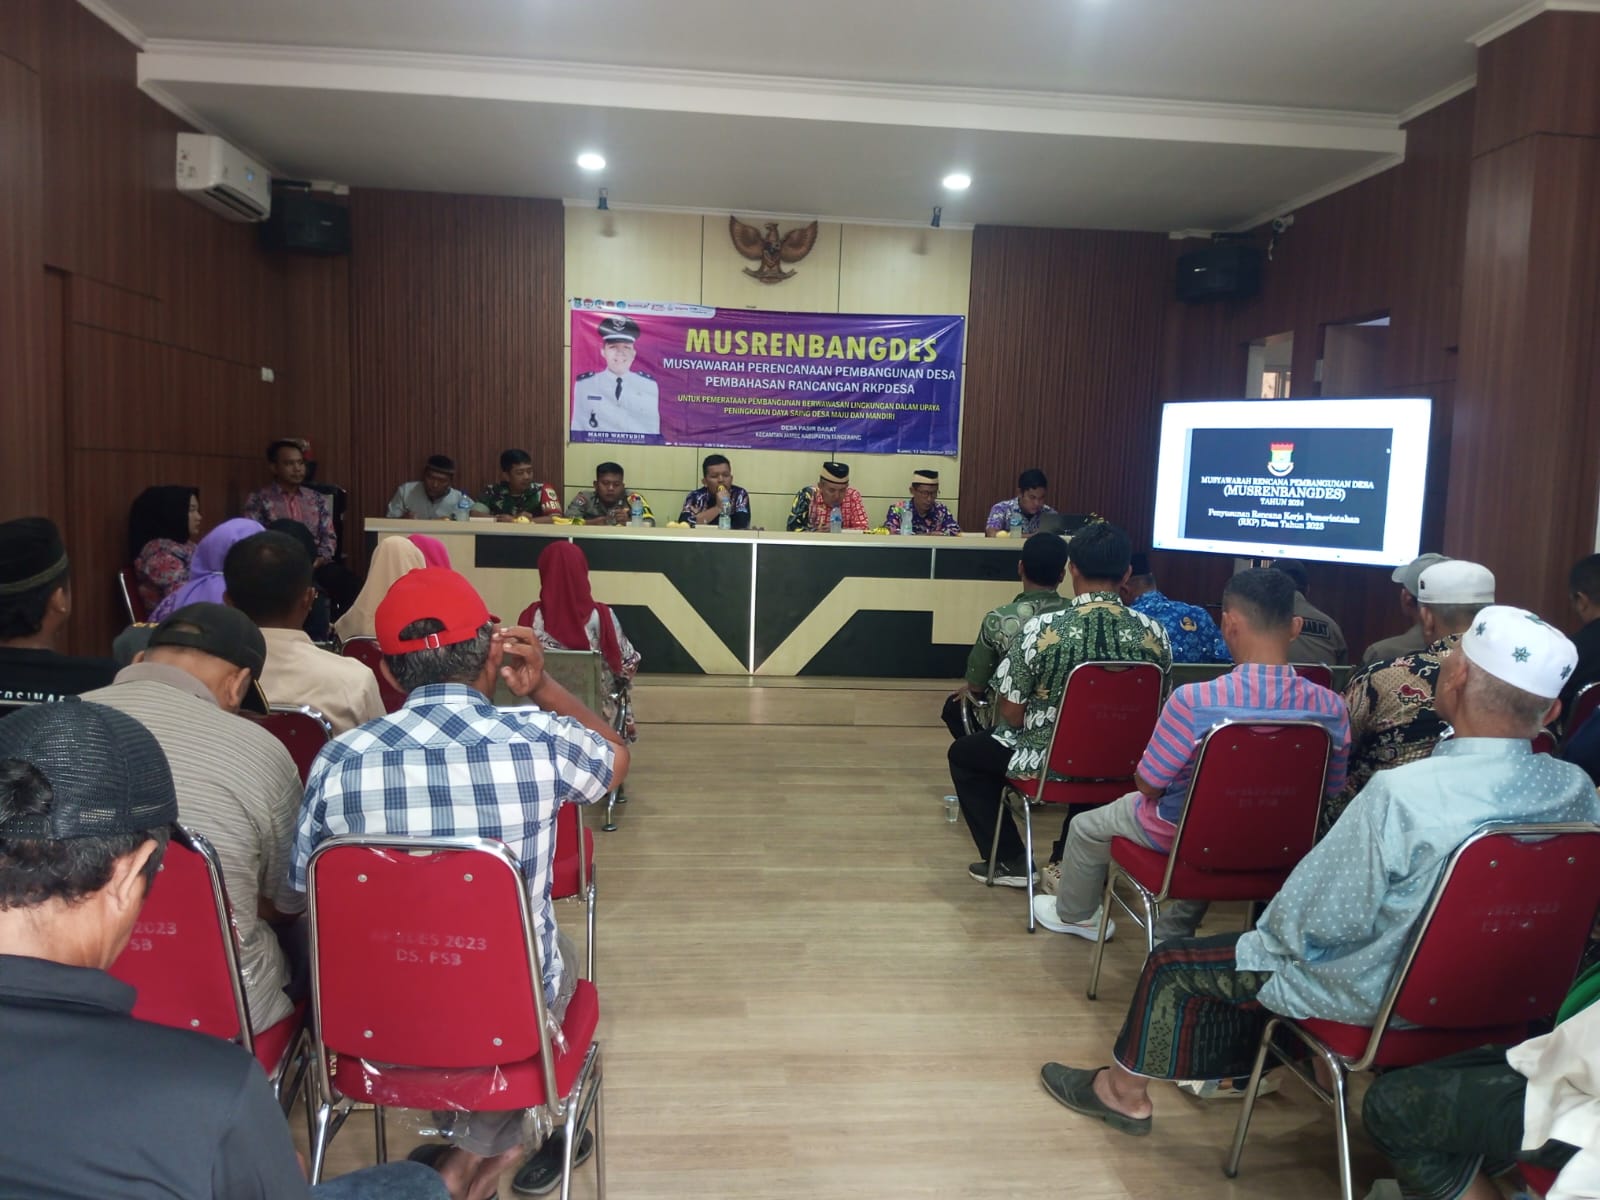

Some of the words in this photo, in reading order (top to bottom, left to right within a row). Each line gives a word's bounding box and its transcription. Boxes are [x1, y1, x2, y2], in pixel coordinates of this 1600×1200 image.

[685, 328, 937, 363] MUSRENBANGDES
[663, 358, 745, 372] MUSYAWARAH
[748, 363, 832, 376] PERENCANAAN
[835, 366, 924, 379] PEMBANGUNAN
[926, 369, 956, 380] DESA
[705, 376, 785, 389] PEMBAHASAN
[788, 380, 860, 392] RANCANGAN
[862, 383, 915, 394] RKPDESA
[678, 395, 701, 403] UNTUK
[702, 396, 746, 405] PEMERATAAN
[748, 398, 801, 407] PEMBANGUNAN
[802, 400, 849, 408] BERWAWASAN
[850, 402, 894, 410] LINGKUNGAN
[895, 403, 918, 411] DALAM
[724, 407, 770, 415] PENINGKATAN
[1201, 476, 1251, 484] MUSYAWARAH
[1252, 478, 1288, 486] RENCANA
[1289, 479, 1351, 488] PEMBANGUNAN
[1352, 481, 1374, 489] DESA
[1223, 484, 1346, 501] (MUSRENBANGDES)
[1260, 498, 1287, 506] TAHUN
[1251, 510, 1282, 519] Rencana
[1283, 512, 1304, 522] Kerja
[1261, 520, 1279, 528] Desa
[1280, 521, 1304, 529] Tahun
[444, 935, 488, 951] 2023
